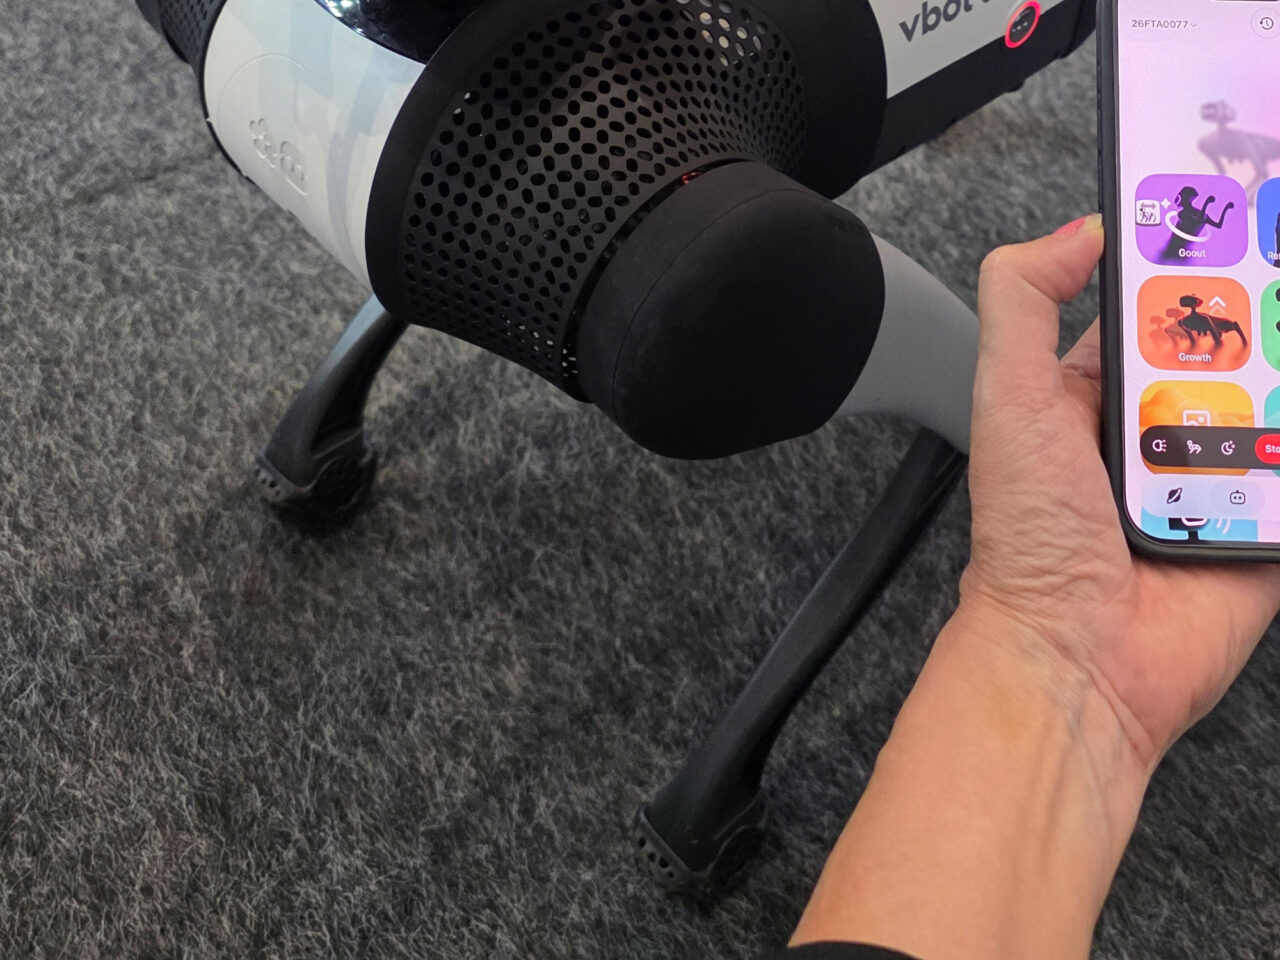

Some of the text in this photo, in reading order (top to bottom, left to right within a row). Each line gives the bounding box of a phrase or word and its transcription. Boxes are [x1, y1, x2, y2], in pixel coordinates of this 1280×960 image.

[1131, 19, 1188, 28] 26FTA0077
[1178, 248, 1206, 258] Goout
[1178, 352, 1212, 363] Growth
